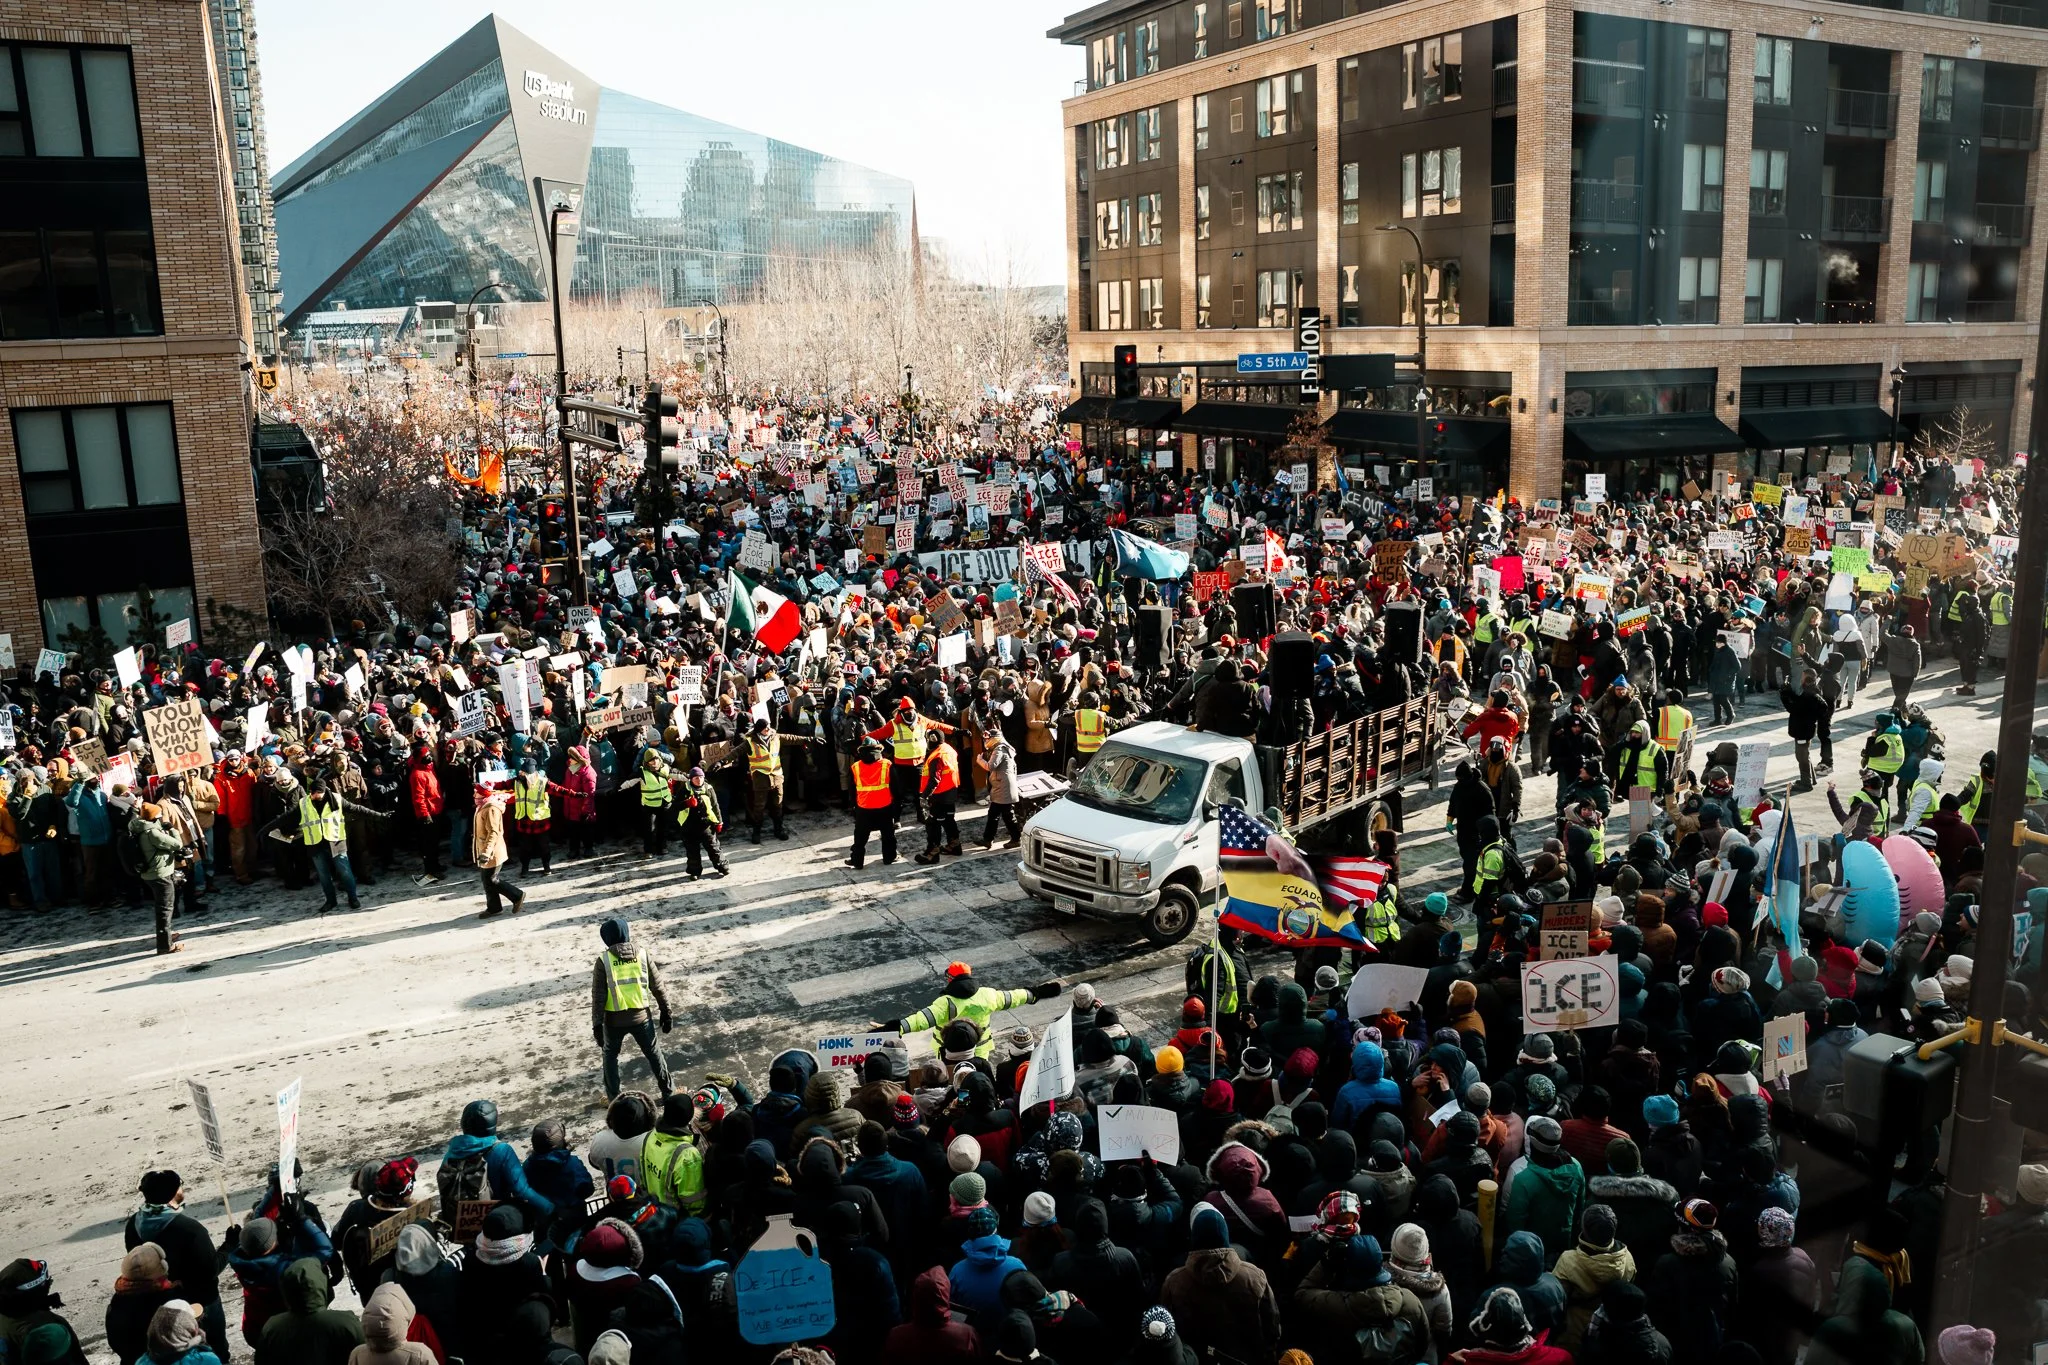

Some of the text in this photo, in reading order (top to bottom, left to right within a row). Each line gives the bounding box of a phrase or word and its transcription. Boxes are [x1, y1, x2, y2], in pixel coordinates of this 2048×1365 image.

[540, 99, 587, 125] stadium
[1301, 317, 1320, 394] EDITION
[1255, 356, 1306, 368] S 5th Av
[898, 451, 911, 459] ICE
[796, 474, 808, 482] ICE
[941, 469, 954, 477] ICE
[906, 481, 920, 490] ICE
[951, 482, 965, 491] ICE
[905, 490, 921, 499] OUT!
[953, 489, 968, 500] OUT!
[977, 492, 991, 501] ICE
[993, 493, 1008, 502] ICE
[1362, 496, 1384, 517] OUT
[1536, 510, 1558, 521] OUT
[1833, 510, 1844, 520] RE
[1886, 509, 1905, 519] FUCK
[897, 528, 911, 538] ICE
[747, 538, 764, 549] ICE
[897, 537, 912, 548] OUT!
[1377, 542, 1411, 553] FEELS
[1787, 541, 1809, 549] COLD
[1038, 548, 1059, 560] ICE
[1526, 547, 1541, 557] ICE
[744, 555, 771, 566] KILLERS
[1379, 555, 1402, 565] LIKE
[940, 550, 1012, 582] ICE OUT
[1195, 573, 1228, 586] PEOPLE
[1592, 583, 1605, 592] OUT
[1195, 587, 1210, 601] NOT
[850, 601, 859, 613] SP
[927, 592, 947, 612] STOP
[571, 609, 589, 617] ONE
[570, 618, 590, 626] WAY
[1619, 615, 1649, 629] ICE OUT
[680, 693, 699, 701] JUSTICE
[774, 689, 787, 697] ICE
[462, 693, 478, 713] ICE
[775, 695, 788, 703] OUT
[150, 702, 192, 723] YOU
[460, 711, 483, 722] OUT OF
[603, 710, 621, 722] OUT
[151, 713, 201, 739] KNOW
[155, 729, 200, 748] WHAT
[72, 737, 100, 756] ICE
[163, 742, 198, 759] YOU
[78, 750, 106, 763] OUT OF
[164, 752, 203, 772] DID
[1280, 885, 1323, 904] ECUADO
[1556, 905, 1577, 915] ICE
[1544, 915, 1585, 927] MURDERS
[1548, 935, 1578, 948] ICE
[1529, 972, 1602, 1013] ICE
[818, 1037, 884, 1050] HONK FOR
[777, 1316, 804, 1326] SPOKE
[810, 1313, 828, 1322] OUT
